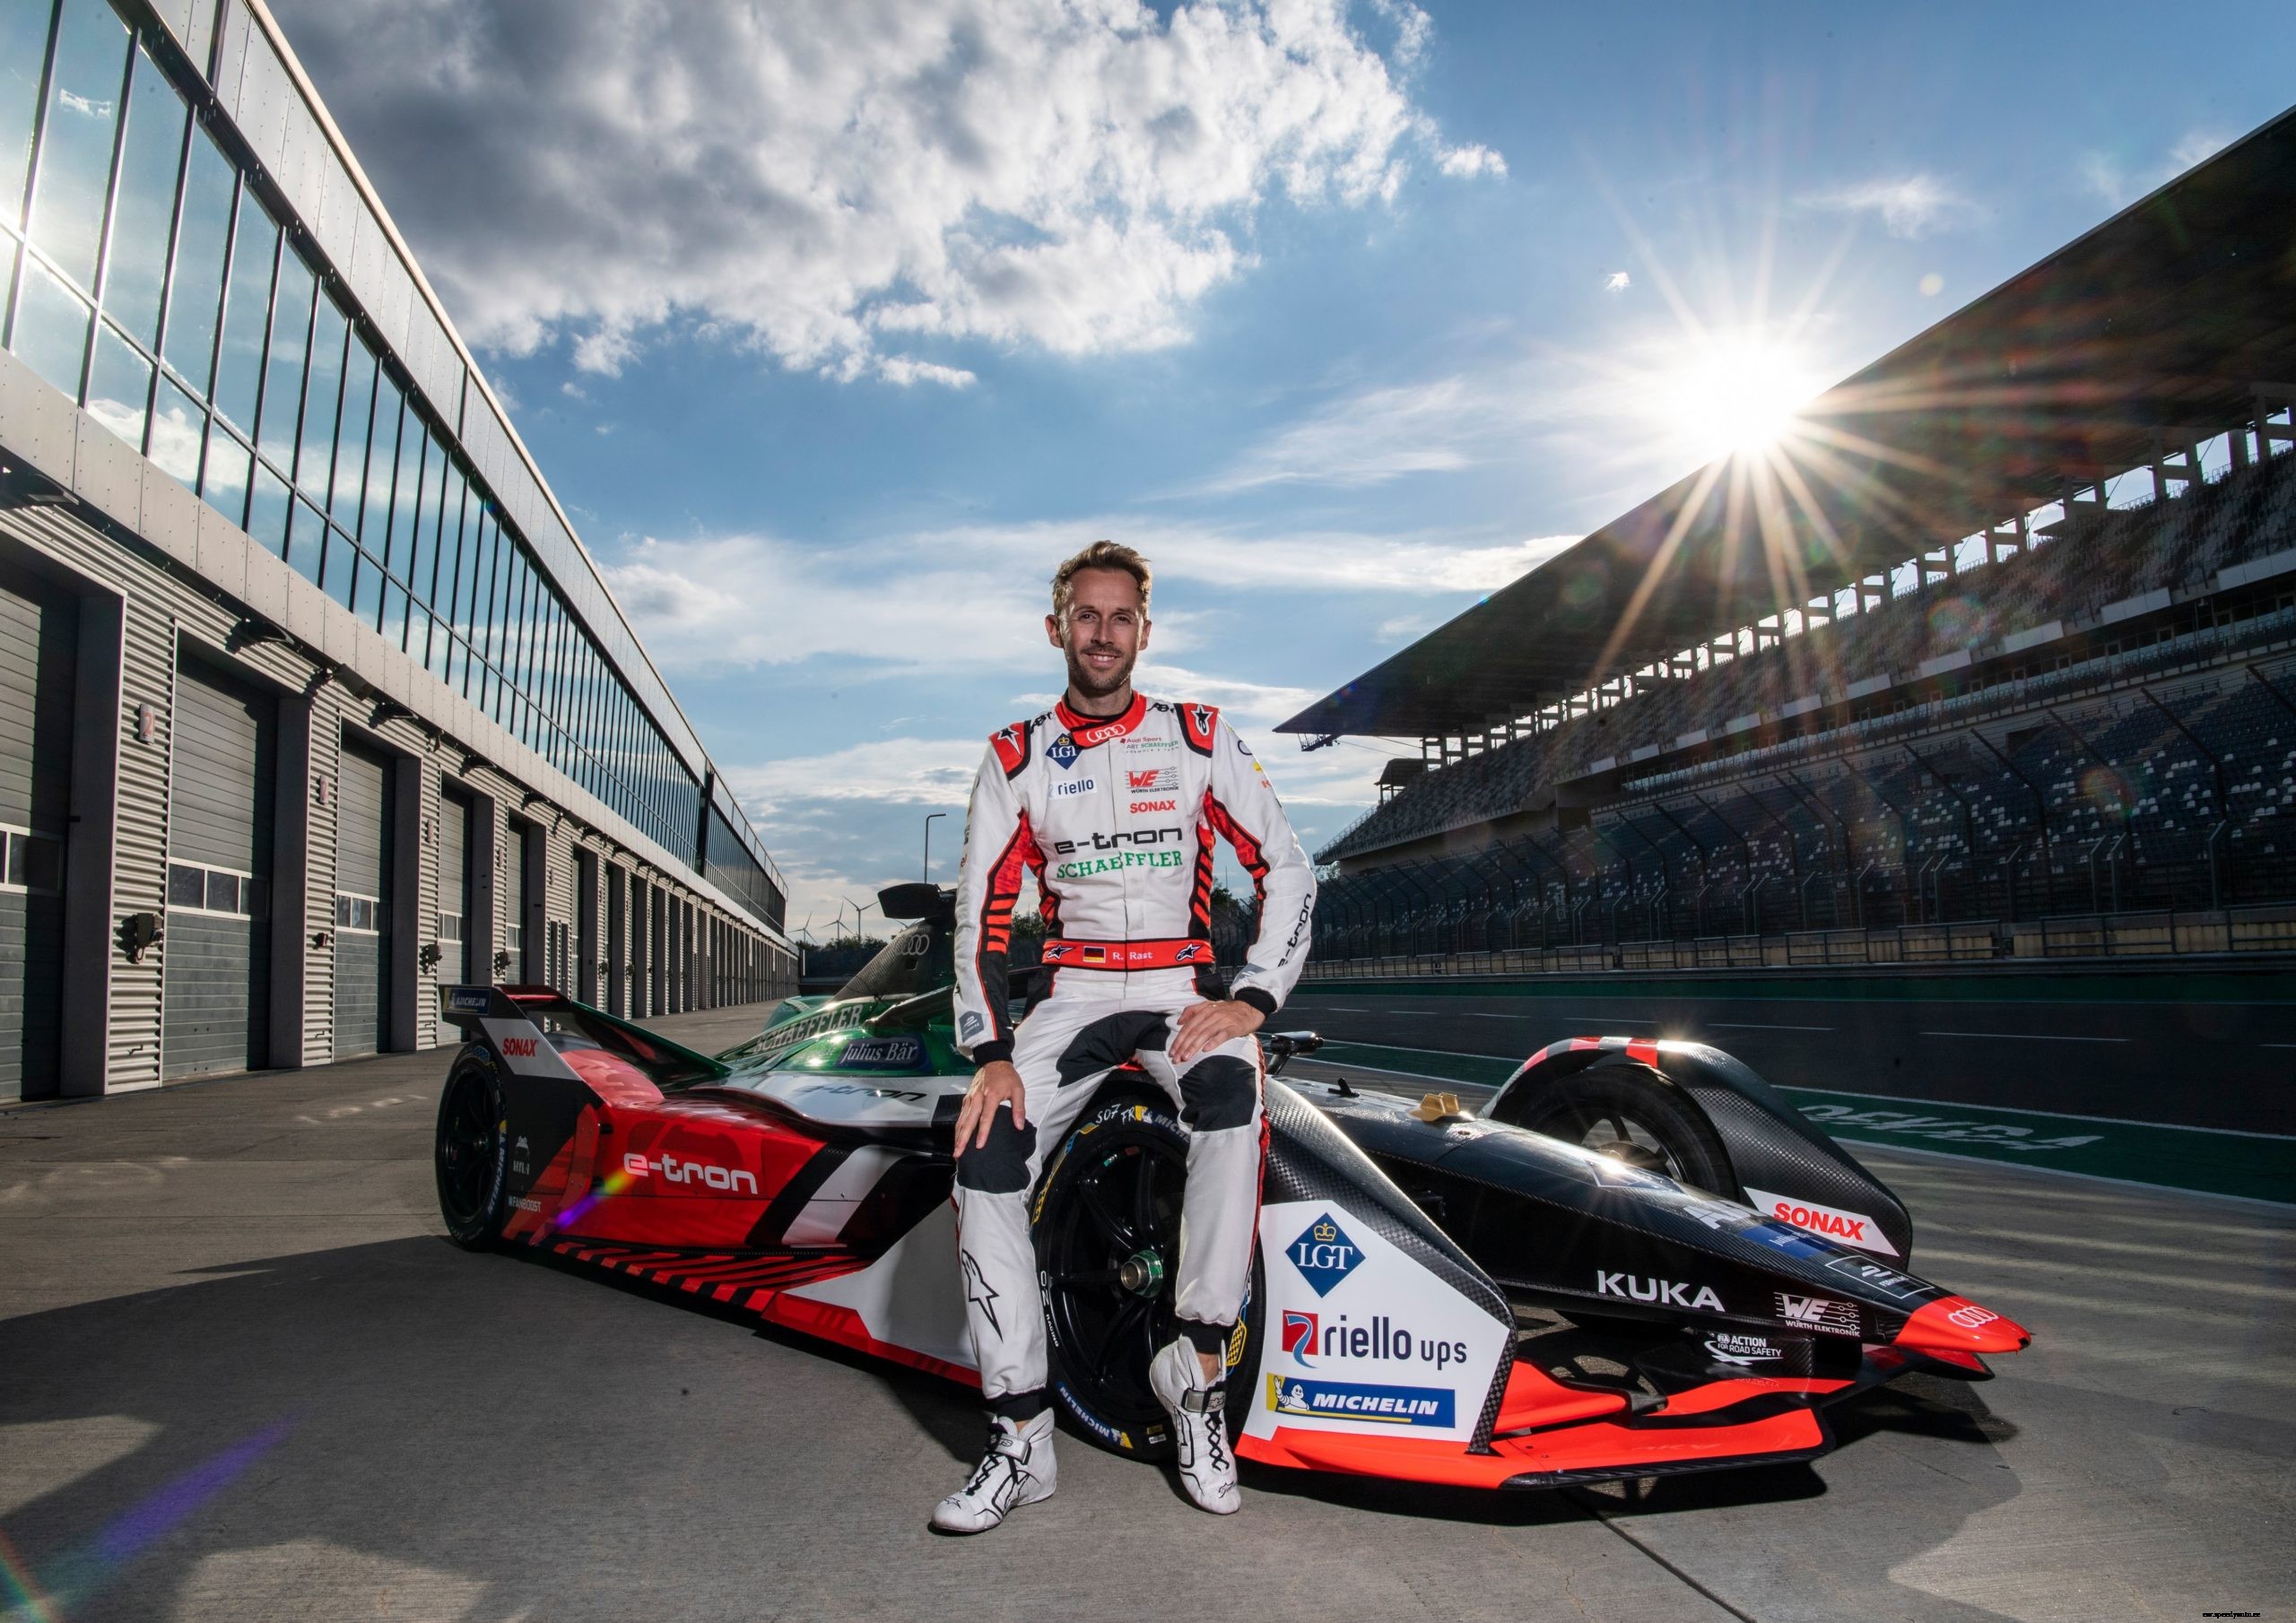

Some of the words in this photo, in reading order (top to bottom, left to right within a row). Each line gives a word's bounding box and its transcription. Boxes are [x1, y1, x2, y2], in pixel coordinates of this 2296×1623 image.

[1057, 779, 1094, 795] riello
[1129, 769, 1160, 788] WE
[1130, 800, 1176, 813] SONAX
[1054, 828, 1183, 855] e-tron
[1057, 850, 1183, 878] SCHAEFFLER
[1277, 893, 1312, 968] e-tron
[1112, 952, 1124, 960] R.
[1130, 951, 1153, 960] Rast
[502, 1038, 536, 1056] SONAX
[839, 1044, 883, 1064] Julius
[885, 1043, 918, 1062] Bär
[794, 1085, 927, 1101] e-tron
[623, 1152, 758, 1194] e-tron
[1774, 1202, 1865, 1242] SONAX
[1297, 1243, 1353, 1270] LGT
[1597, 1270, 1726, 1312] KUKA
[1782, 1294, 1831, 1321] WE
[1786, 1320, 1813, 1331] WÜRTH
[1814, 1324, 1861, 1338] ELEKTRONIK
[1325, 1315, 1412, 1359] riello
[1421, 1340, 1467, 1370] ups
[1729, 1344, 1750, 1354] ROAD
[1752, 1347, 1782, 1357] SAFETY
[1731, 1335, 1767, 1347] ACTION
[1059, 1386, 1110, 1438] MICHELIN
[1312, 1393, 1439, 1416] MICHELIN
